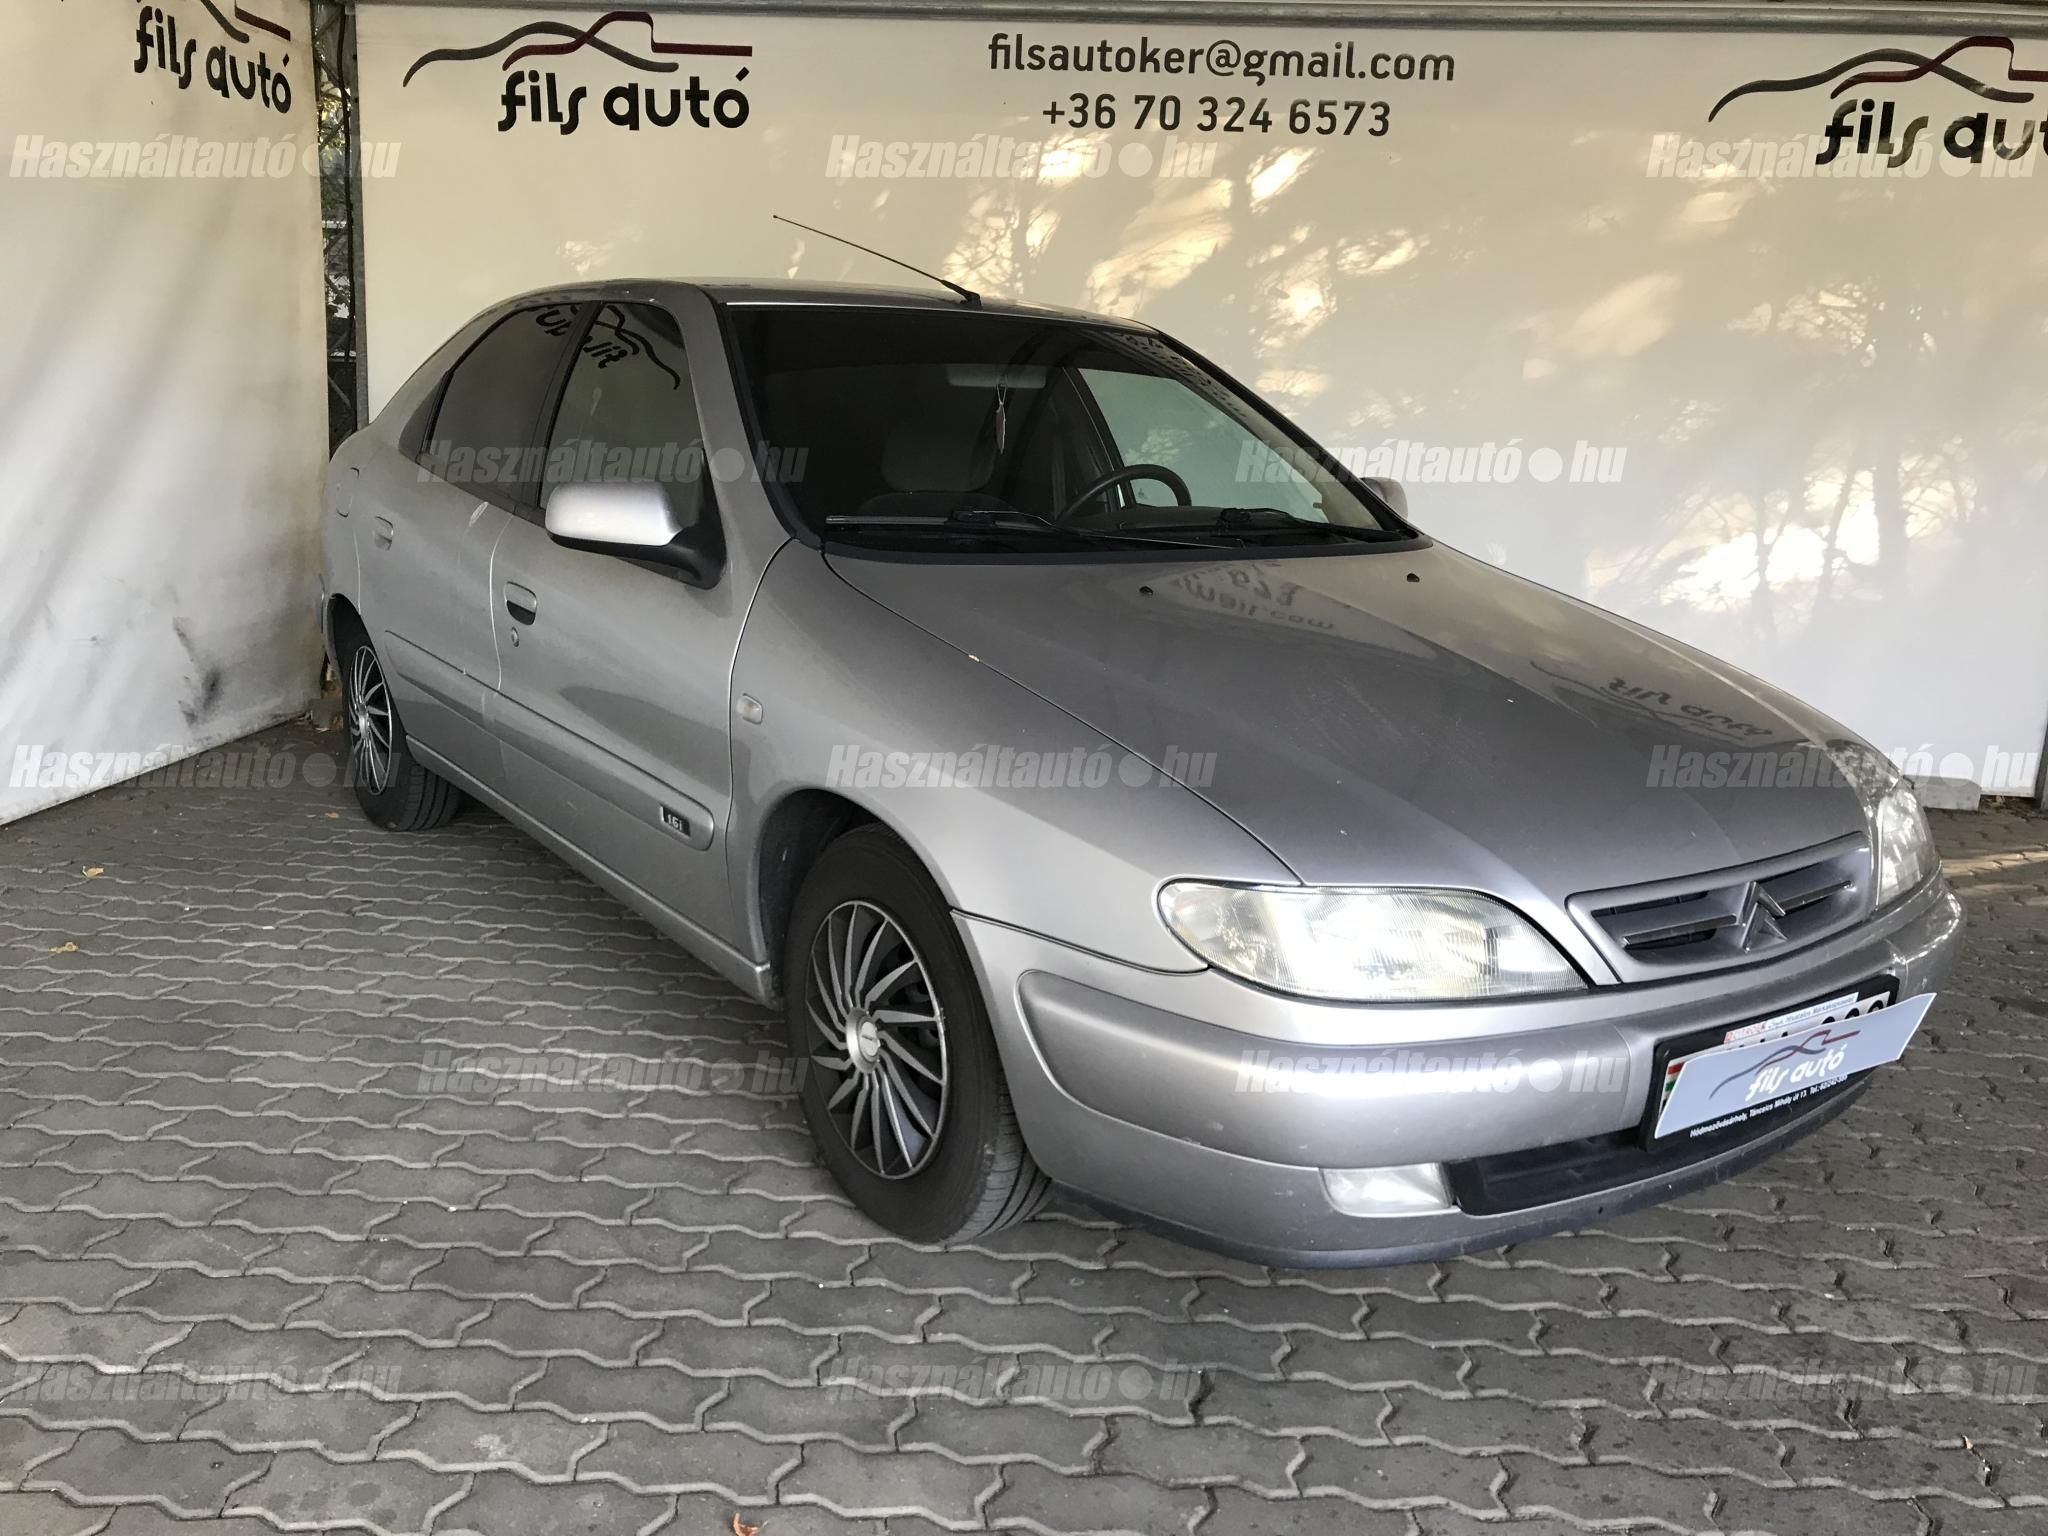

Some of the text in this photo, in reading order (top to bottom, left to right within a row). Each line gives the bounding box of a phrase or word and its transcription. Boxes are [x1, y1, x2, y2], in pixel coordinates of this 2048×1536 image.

[134, 5, 292, 114] fils autó
[988, 32, 1456, 86] filsautoker@gmail.com
[498, 67, 750, 135] fils autó
[1042, 93, 1392, 137] +36 70 324 6573
[1815, 98, 1928, 168] fils
[1744, 1043, 1848, 1102] fils autó
